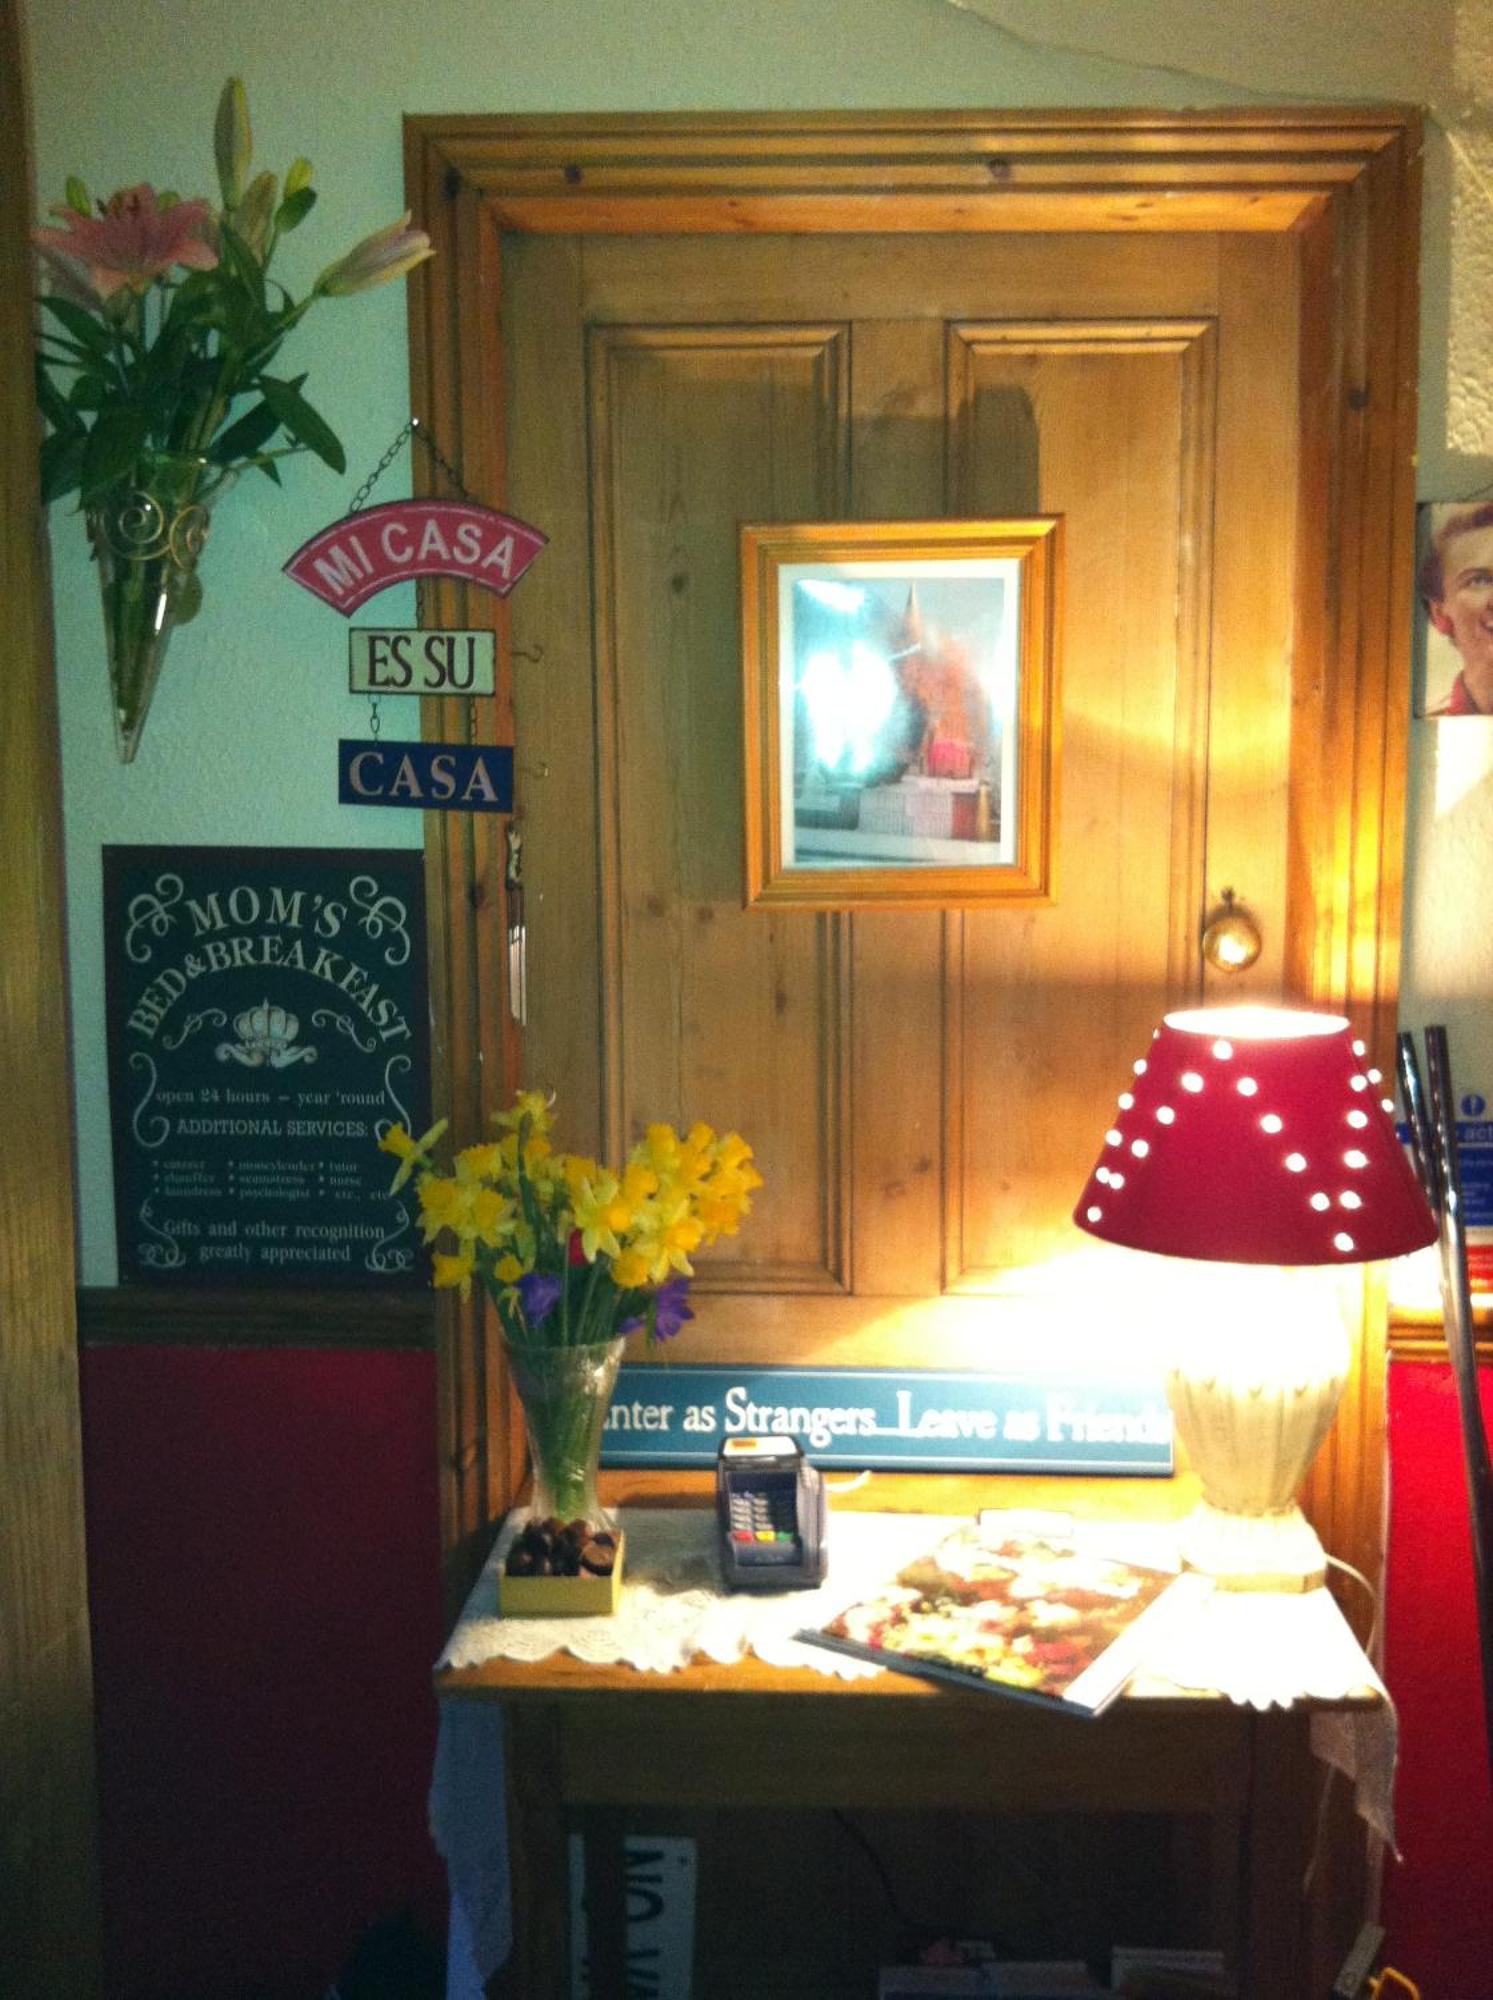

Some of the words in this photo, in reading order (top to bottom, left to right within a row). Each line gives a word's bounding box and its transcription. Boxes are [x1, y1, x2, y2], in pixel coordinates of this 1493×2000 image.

[313, 534, 375, 597] MI
[380, 518, 518, 581] CASA
[367, 635, 413, 689] ES
[424, 635, 476, 690] SU
[349, 751, 499, 803] CASA
[184, 885, 348, 939] MOM'S
[155, 1089, 194, 1107] open
[200, 1087, 221, 1103] 24
[226, 1087, 271, 1103] hours
[298, 1091, 330, 1108] year
[177, 1118, 282, 1136] ADDITIONAL
[329, 1160, 358, 1173] tutor
[239, 1186, 311, 1201] psychologist
[163, 1219, 200, 1238] Gifts
[207, 1220, 238, 1238] and
[244, 1220, 287, 1239] other
[295, 1222, 386, 1244] recognition
[199, 1241, 250, 1264] greatly
[260, 1243, 352, 1265] appreciated
[603, 1400, 675, 1431] nter
[683, 1405, 718, 1433] as
[1002, 1407, 1039, 1442] as
